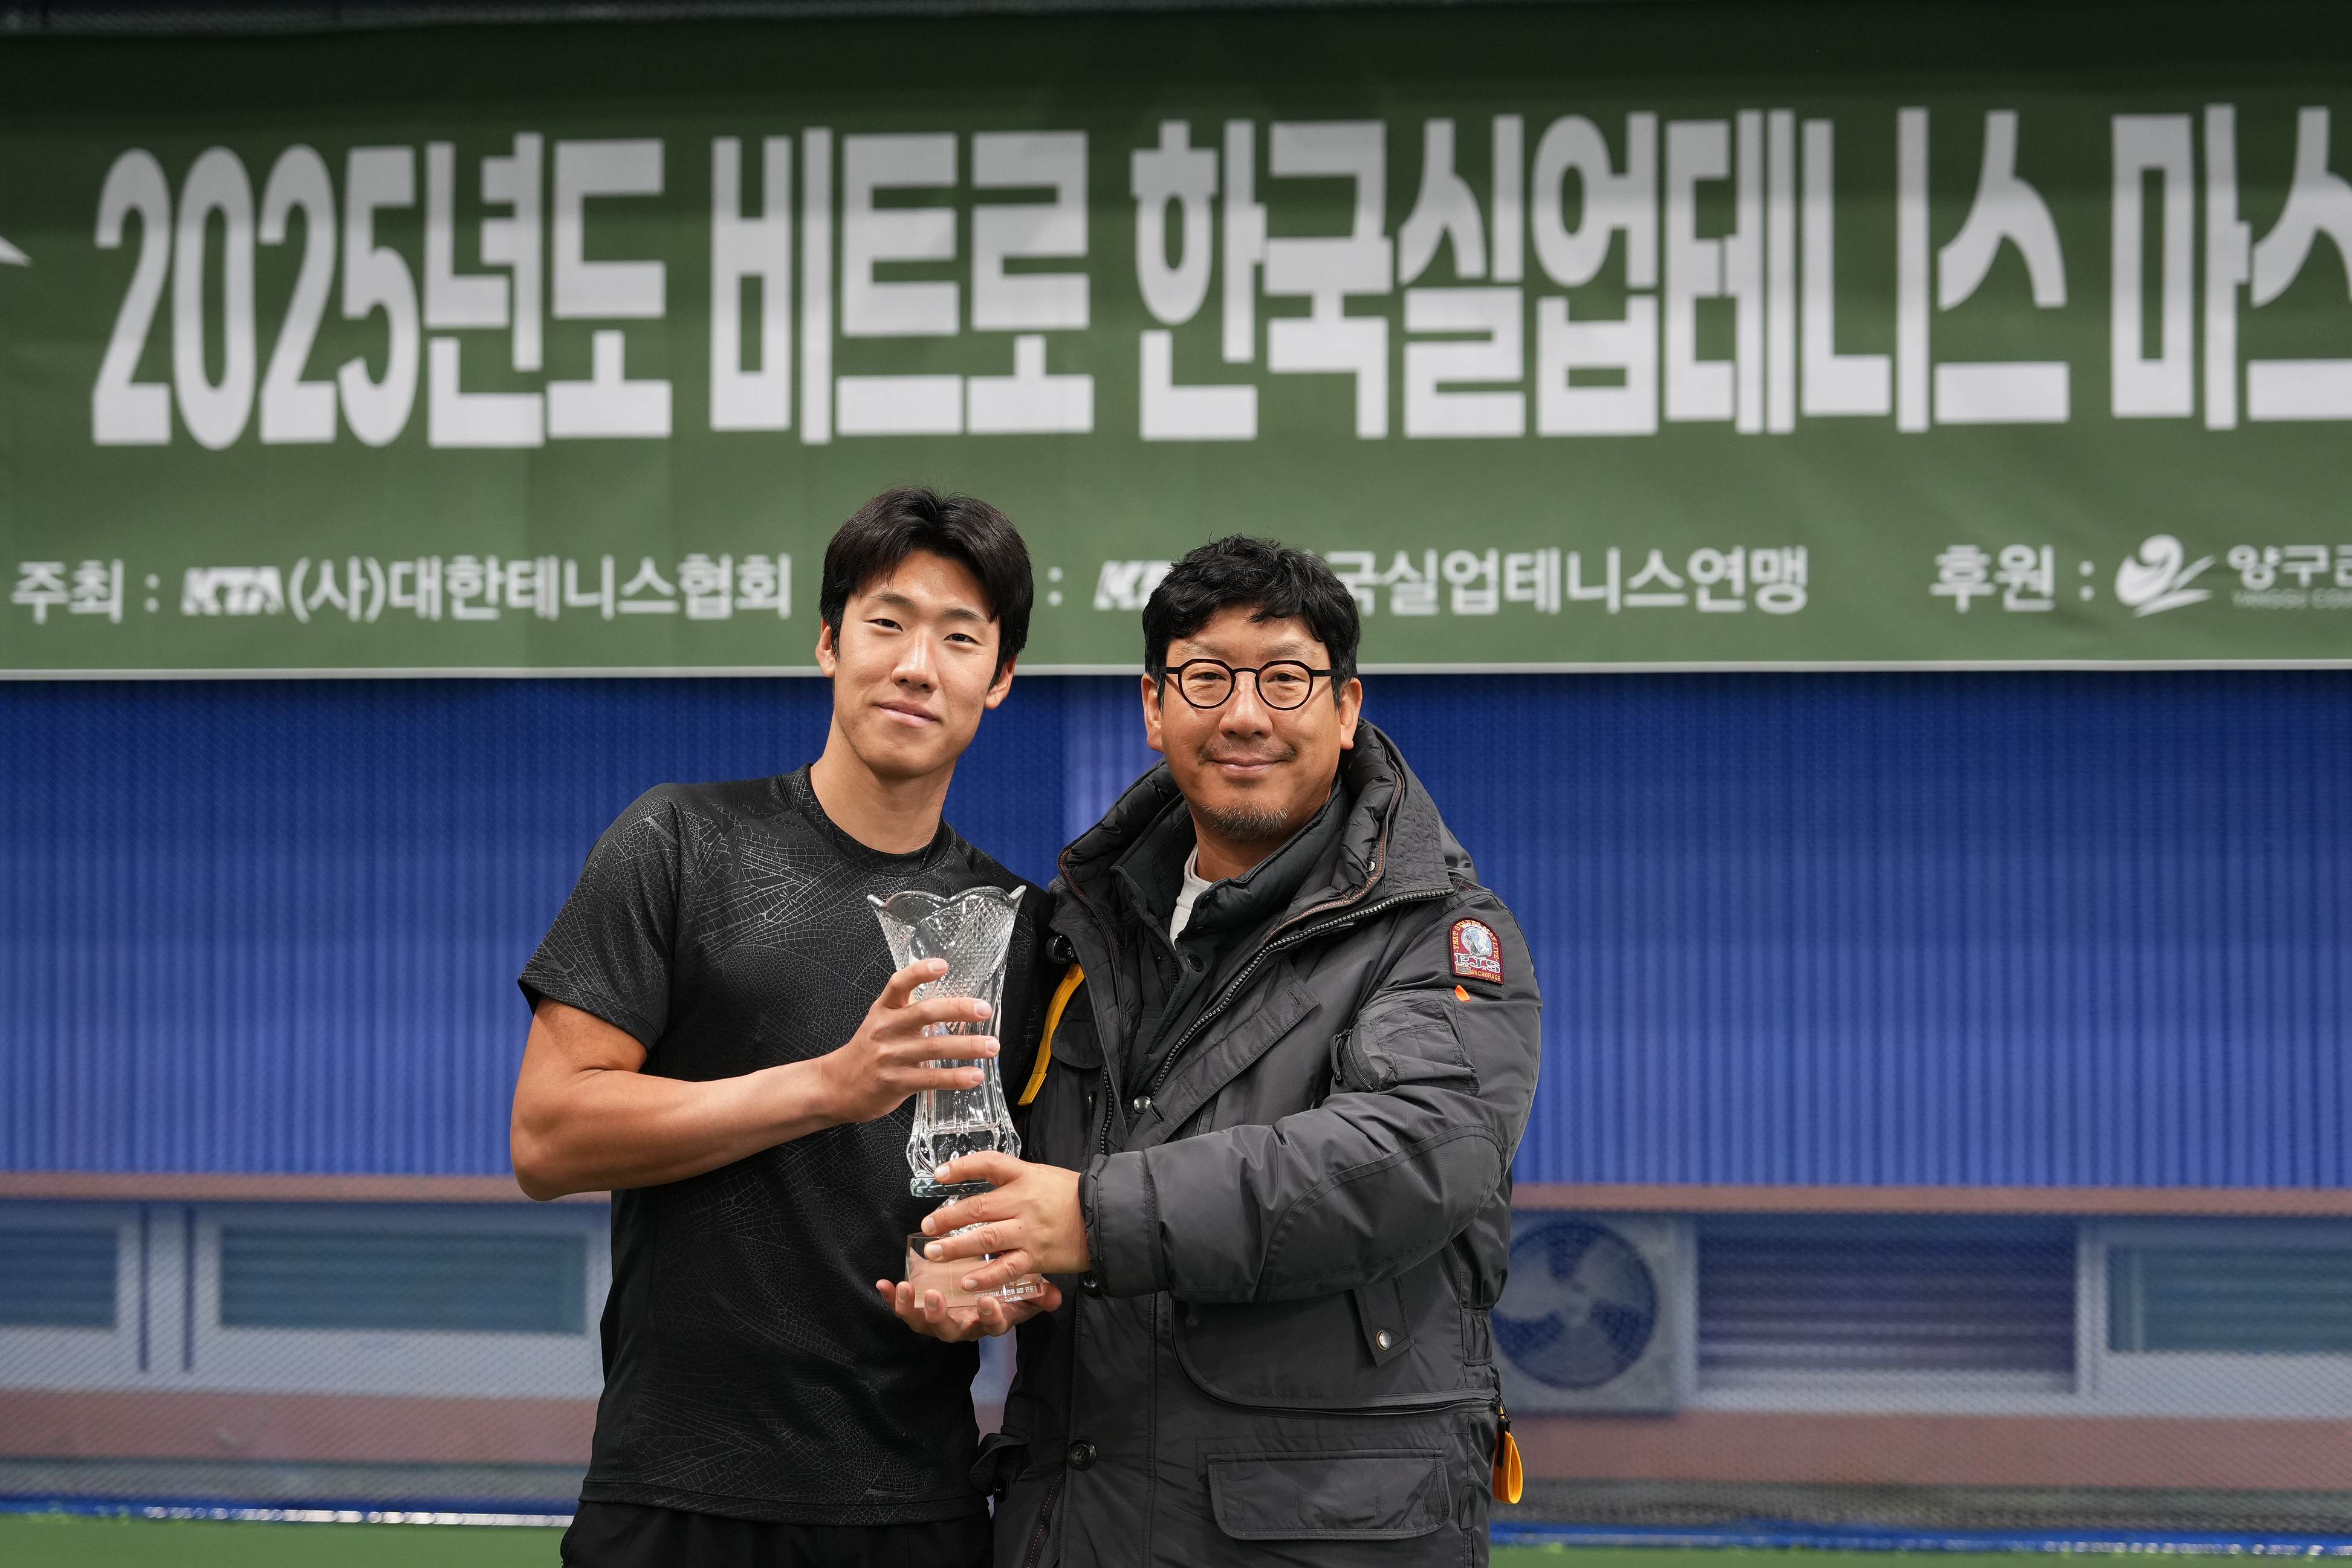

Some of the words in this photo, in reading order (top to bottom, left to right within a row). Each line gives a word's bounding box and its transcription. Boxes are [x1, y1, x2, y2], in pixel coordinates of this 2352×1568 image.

[92, 132, 673, 451] 2025년도
[710, 126, 1095, 445] 비트로
[1130, 105, 2070, 442] 한국실업테니스
[9, 559, 125, 624] 주최
[181, 566, 286, 616] KTA
[1323, 545, 1809, 617] 국실업테니스연맹
[1929, 543, 2056, 614] 후원
[1471, 969, 1502, 982] ANCHORAGE
